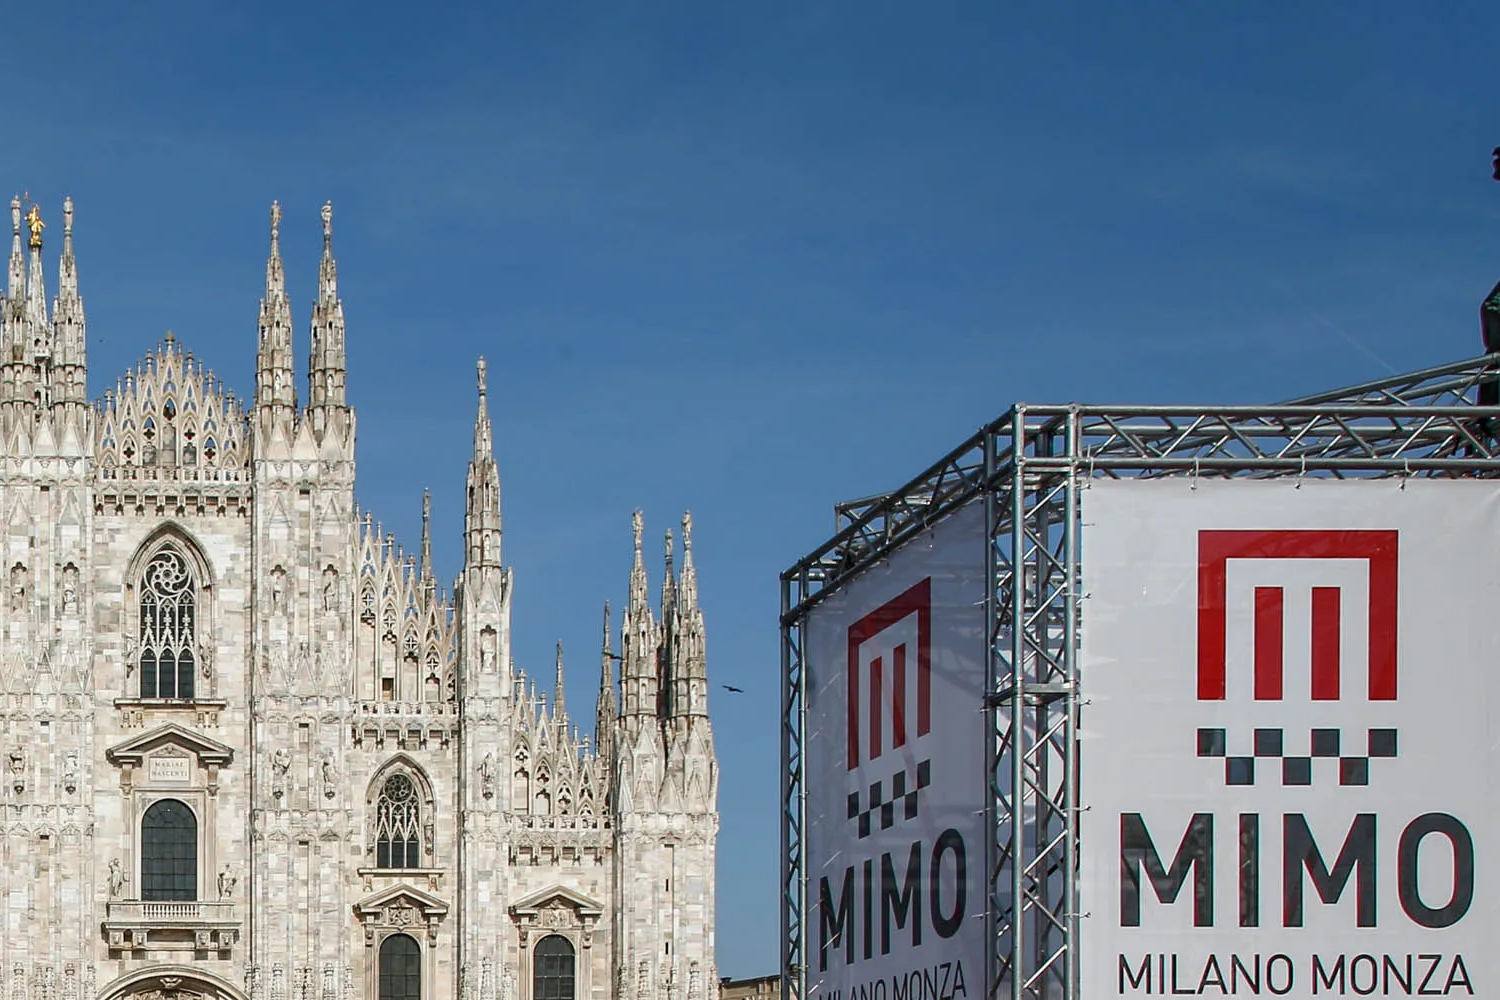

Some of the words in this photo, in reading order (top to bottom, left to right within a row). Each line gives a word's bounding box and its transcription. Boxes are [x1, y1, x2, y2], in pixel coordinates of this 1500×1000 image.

[819, 828, 967, 973] MIMO
[1121, 812, 1475, 929] MIMO
[1118, 953, 1294, 996] MILANO
[1312, 953, 1475, 996] MONZA
